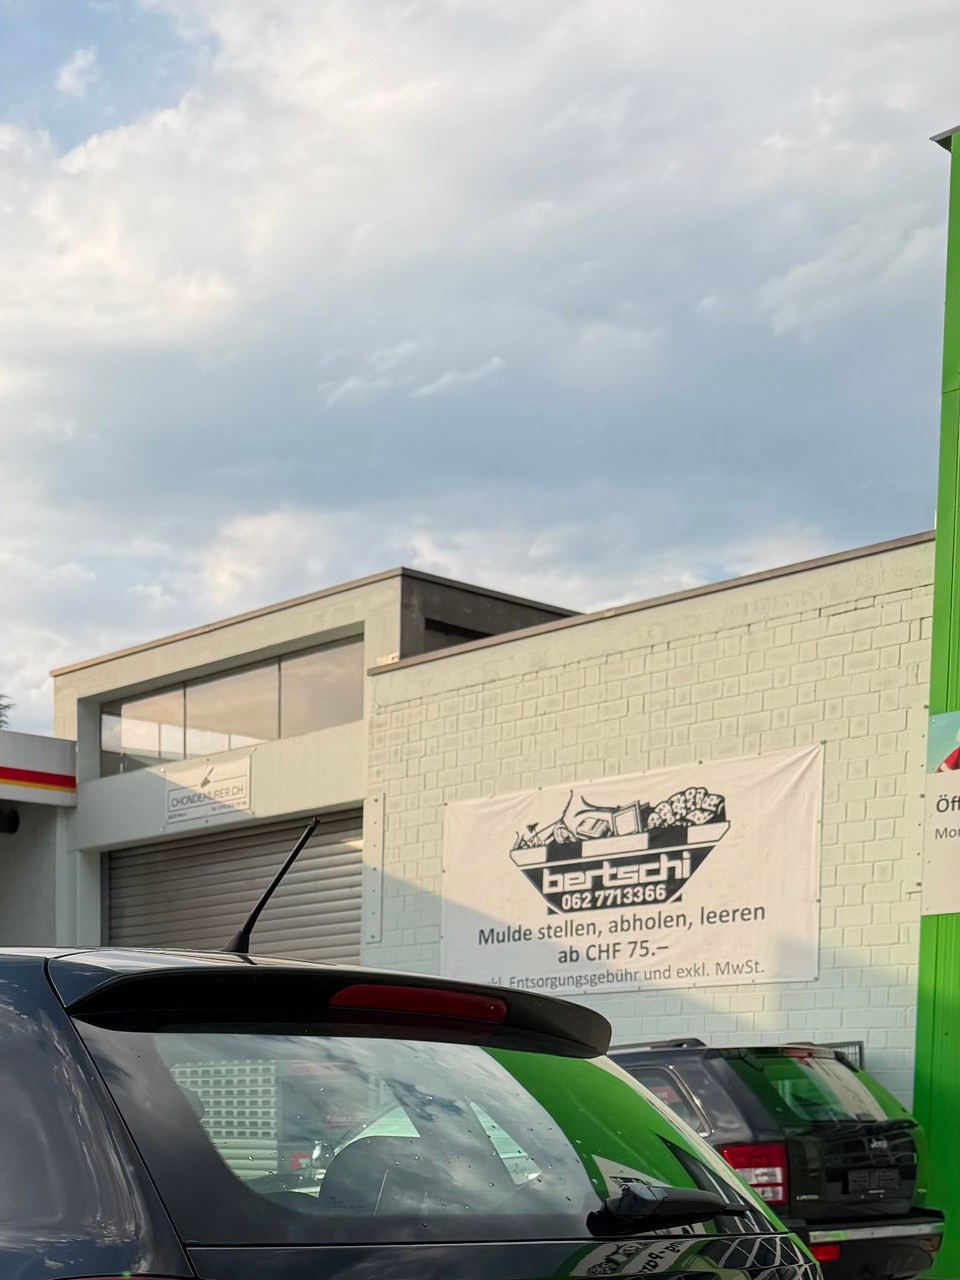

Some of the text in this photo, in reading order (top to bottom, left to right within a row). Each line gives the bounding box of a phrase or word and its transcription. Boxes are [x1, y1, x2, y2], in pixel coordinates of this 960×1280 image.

[542, 851, 690, 895] bertschi
[561, 884, 667, 910] 062 7713366
[478, 906, 766, 946] Mulde stellen, abholen, leeren
[558, 945, 580, 964] ab
[585, 942, 622, 961] CHF
[509, 967, 640, 990] Entsorgungsgebühr
[643, 965, 672, 981] und
[676, 962, 710, 979] exkl.
[715, 959, 765, 976] MwSt.
